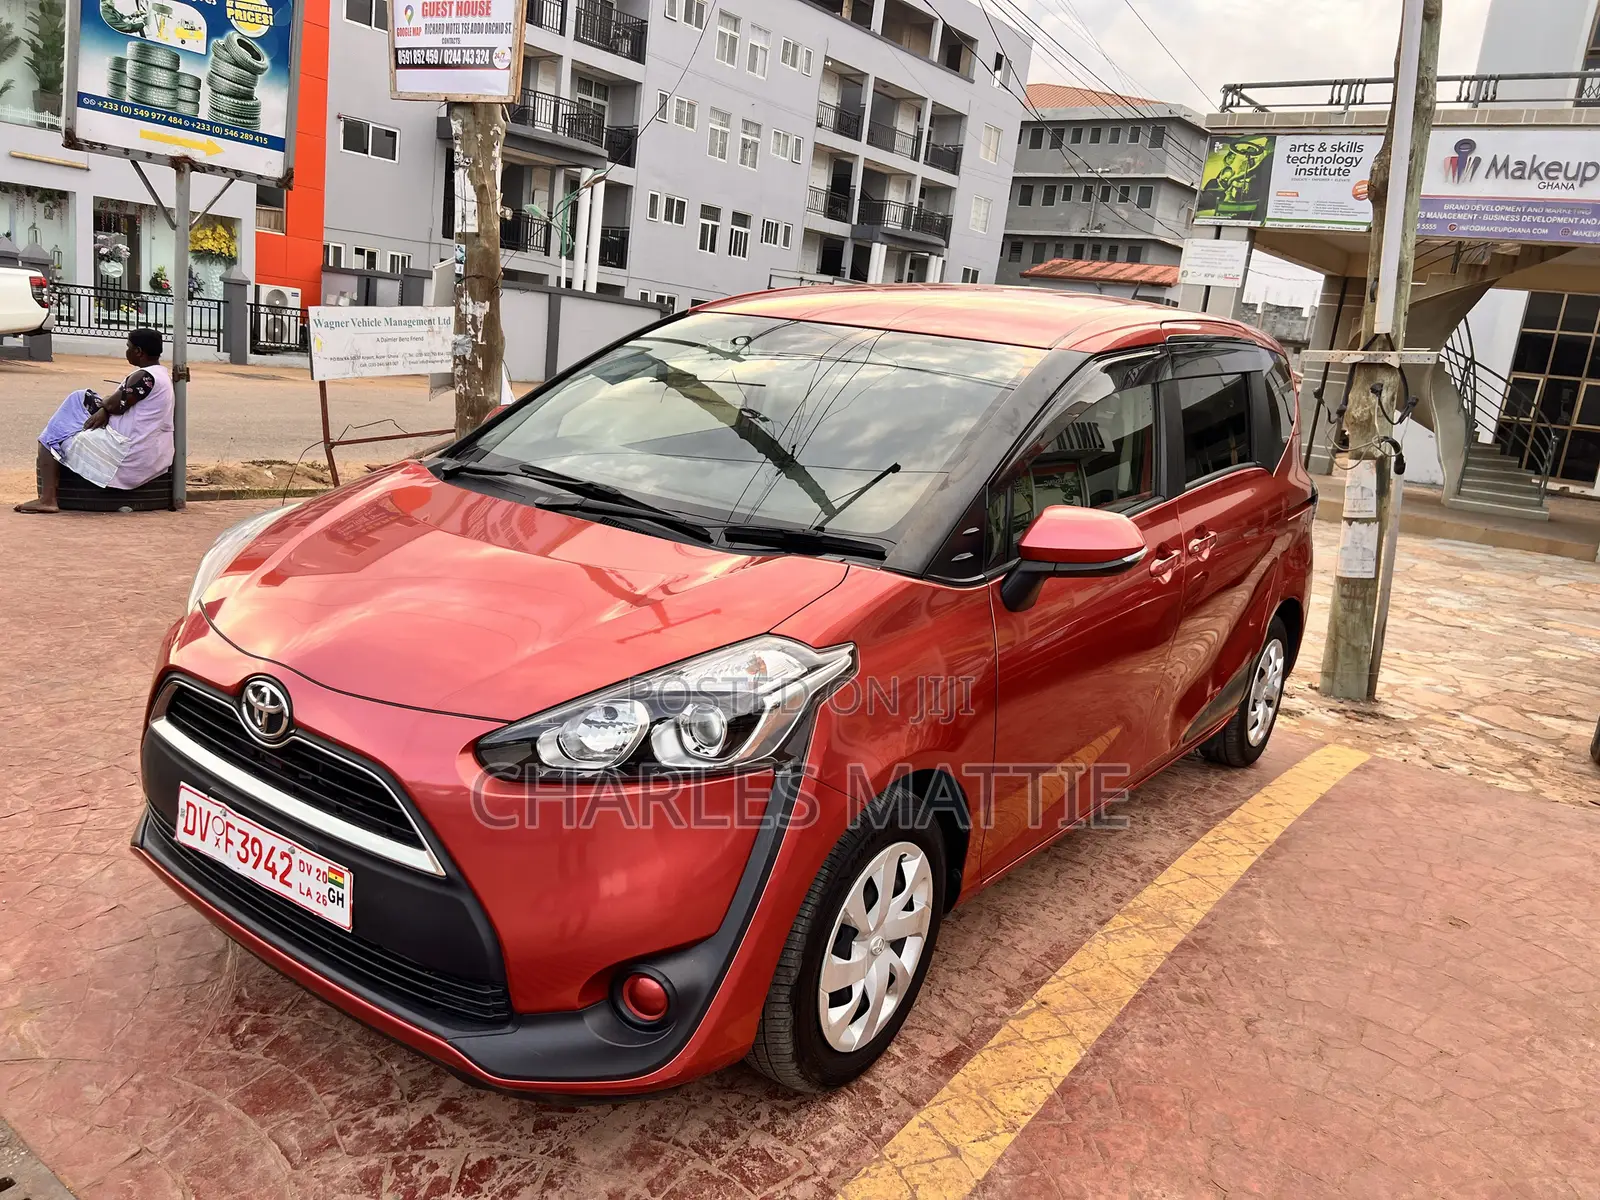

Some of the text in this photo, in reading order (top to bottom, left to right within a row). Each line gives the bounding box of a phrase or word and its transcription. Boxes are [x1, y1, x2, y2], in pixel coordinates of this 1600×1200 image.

[226, 8, 274, 26] PRICES!
[421, 1, 492, 17] GUEST HOUSE
[475, 49, 490, 64] 324
[97, 101, 183, 125] +233 (0) 549 977 484
[191, 121, 211, 131] +233
[212, 125, 223, 135] (0)
[224, 128, 239, 137] 546
[254, 135, 268, 144] 415
[1289, 141, 1364, 153] arts & skills
[1286, 153, 1363, 168] technology
[1294, 164, 1351, 177] institute
[1484, 154, 1600, 188] Makeup
[1537, 181, 1575, 191] GHANA
[1443, 203, 1470, 211] BRAND
[1471, 204, 1526, 213] DEVELOPMENT
[1526, 206, 1543, 214] AND
[1426, 211, 1478, 220] MANAGEMENT
[1483, 213, 1520, 222] BUSINESS
[1521, 214, 1579, 225] DEVELOPMENT
[1579, 217, 1598, 226] AND
[313, 316, 451, 330] Wagner Vehicle Management Ltd
[183, 800, 211, 842] DV
[224, 821, 294, 889] F3942
[298, 858, 328, 885] DV 20
[298, 881, 328, 907] LA 26
[327, 887, 345, 908] GH
